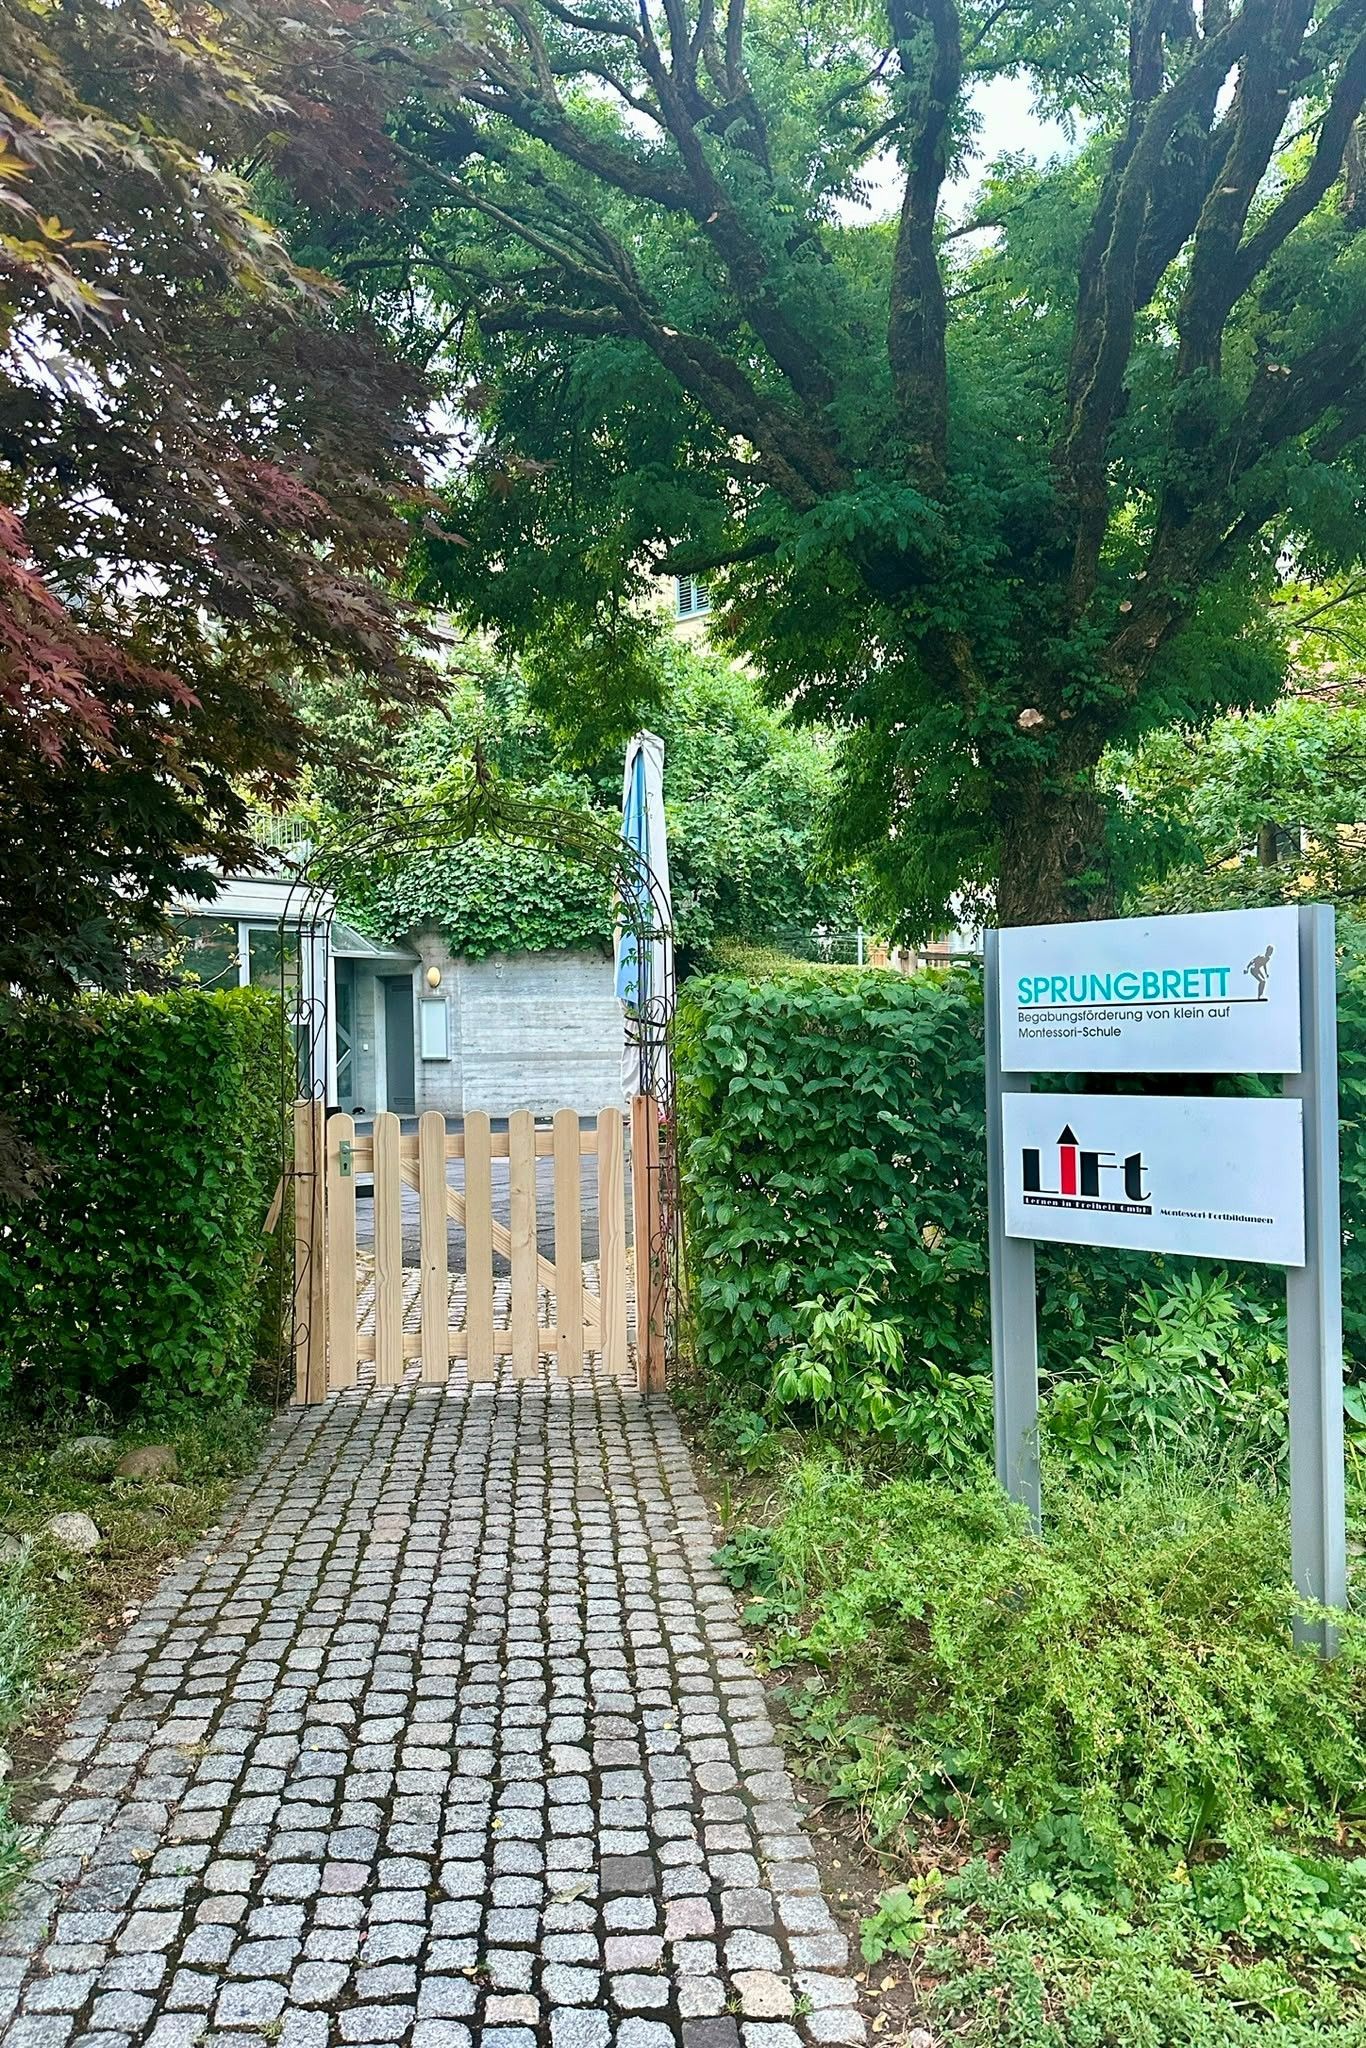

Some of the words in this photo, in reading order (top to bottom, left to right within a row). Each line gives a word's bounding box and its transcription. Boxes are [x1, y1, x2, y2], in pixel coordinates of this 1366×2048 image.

[1018, 968, 1231, 1004] SPRUNGBRETT
[1018, 1009, 1143, 1025] Begabungsförderung
[1146, 1009, 1170, 1020] von
[1173, 1007, 1204, 1019] klein
[1208, 1006, 1231, 1018] auf
[1018, 1026, 1122, 1039] Montessori-Schule
[1025, 1197, 1059, 1206] Lernen
[1062, 1199, 1072, 1208] in
[1075, 1201, 1116, 1211] Freiheit
[1160, 1209, 1206, 1219] Montessori
